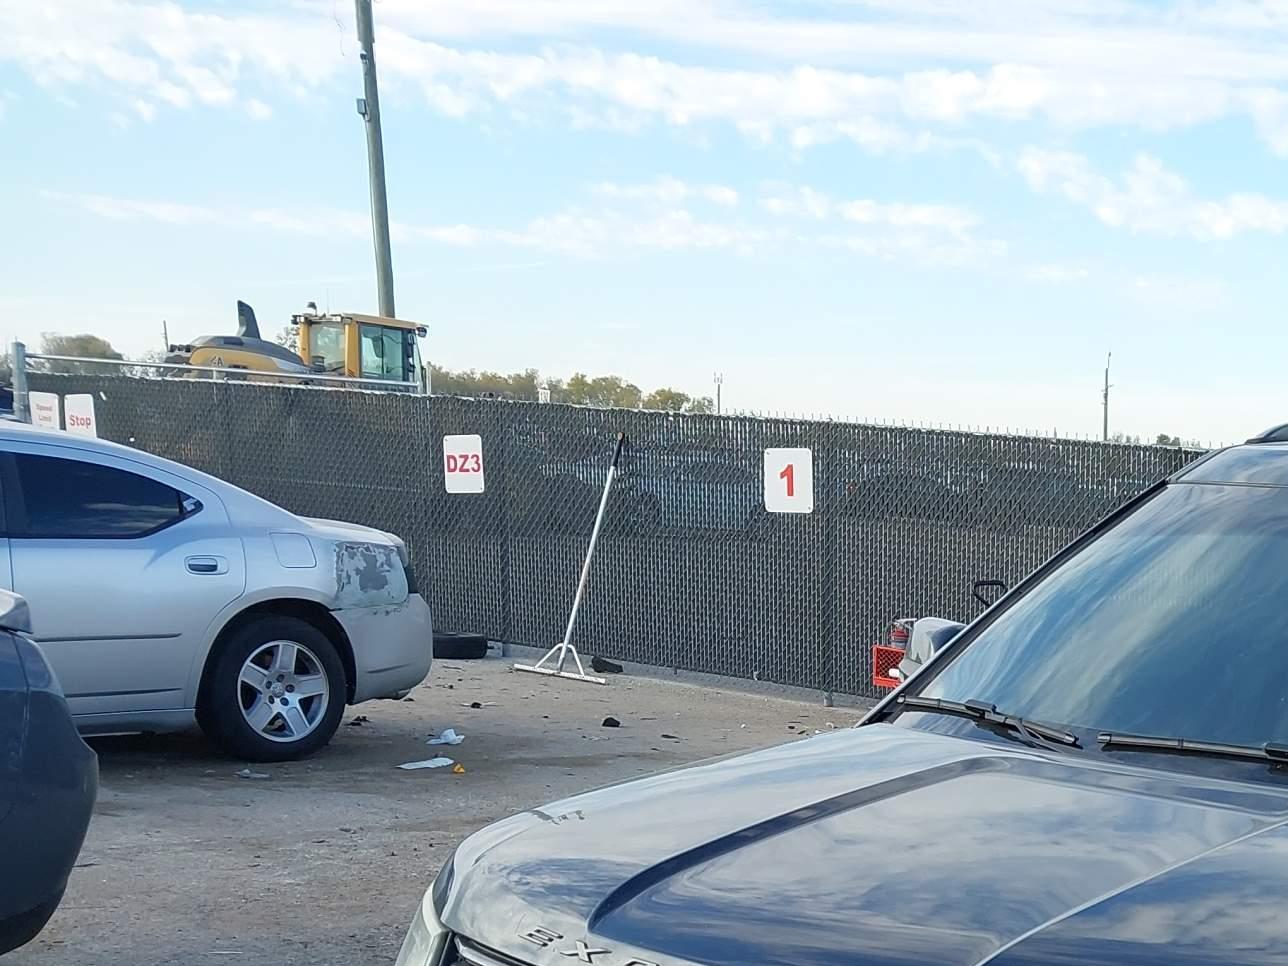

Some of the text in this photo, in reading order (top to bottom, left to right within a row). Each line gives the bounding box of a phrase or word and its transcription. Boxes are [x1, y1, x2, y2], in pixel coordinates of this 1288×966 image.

[69, 414, 92, 428] Stop
[446, 454, 481, 473] DZ3
[779, 463, 796, 497] 1
